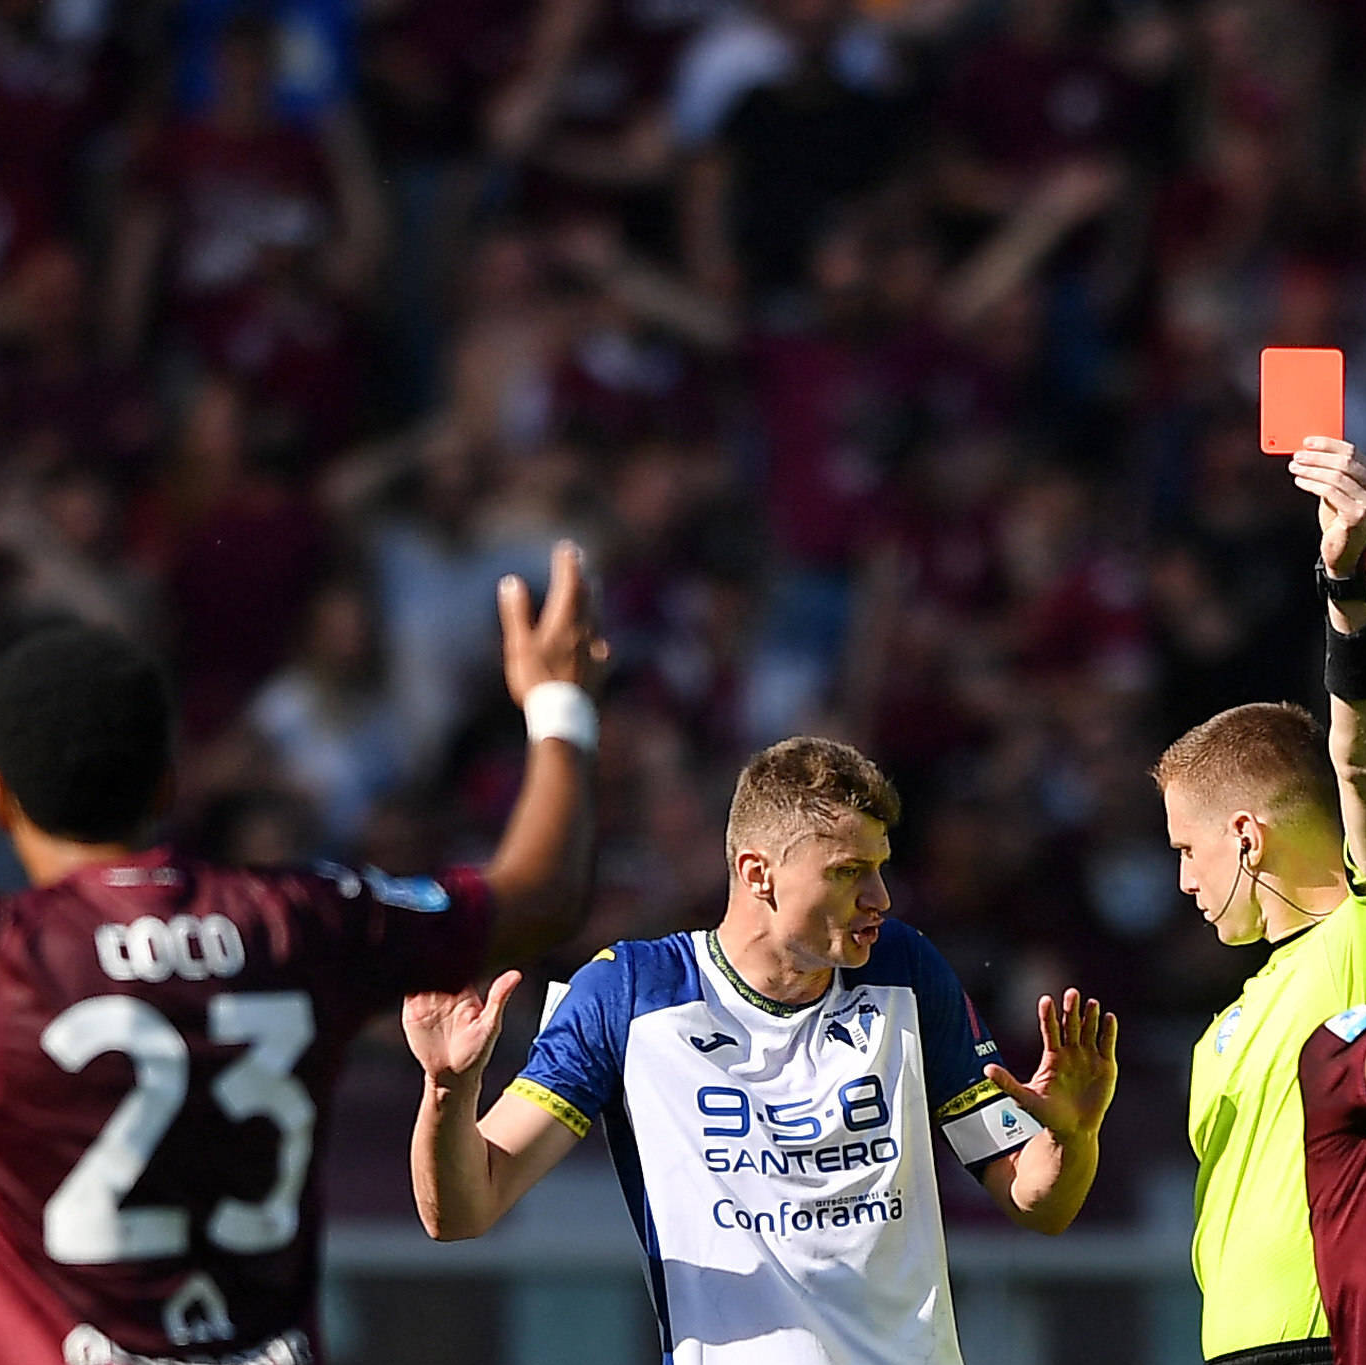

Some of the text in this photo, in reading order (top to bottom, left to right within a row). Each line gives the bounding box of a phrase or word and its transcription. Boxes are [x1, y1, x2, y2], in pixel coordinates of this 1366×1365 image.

[93, 913, 246, 983] COCO
[41, 992, 315, 1264] 23
[705, 1137, 899, 1175] SANTERO
[712, 1197, 903, 1237] Conforama
